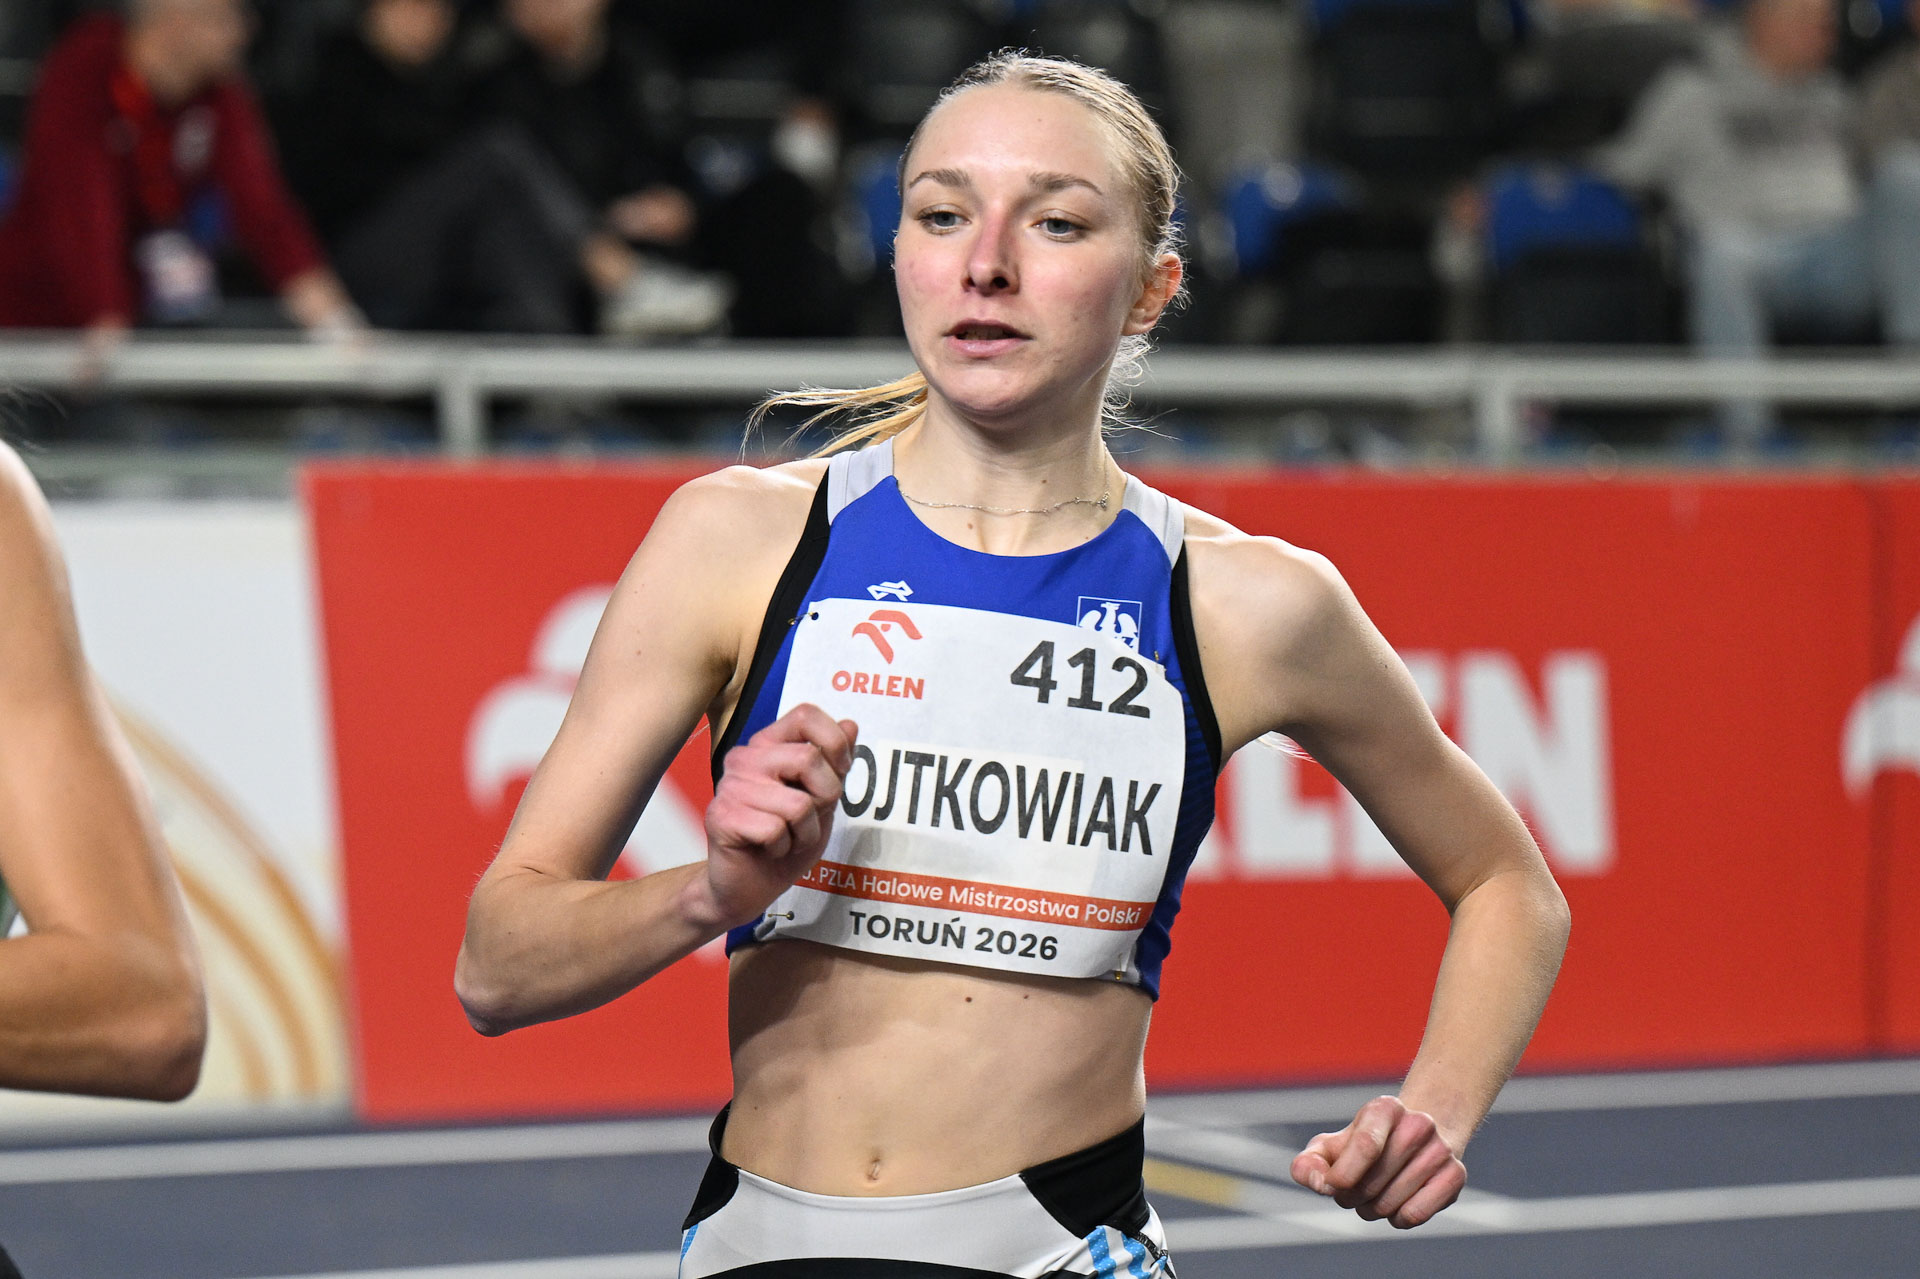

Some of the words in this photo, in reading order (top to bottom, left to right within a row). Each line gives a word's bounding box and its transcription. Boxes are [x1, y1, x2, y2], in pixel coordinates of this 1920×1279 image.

[831, 670, 925, 700] ORLEN
[1010, 640, 1151, 719] 412
[839, 744, 1163, 856] OJTKOWIAK
[819, 867, 857, 890] PZLA
[862, 874, 944, 899] Halowe
[949, 886, 1079, 919] Mistrzostwa
[1085, 904, 1142, 925] Polski
[849, 911, 966, 949] TORUŃ
[974, 927, 1059, 961] 2026
